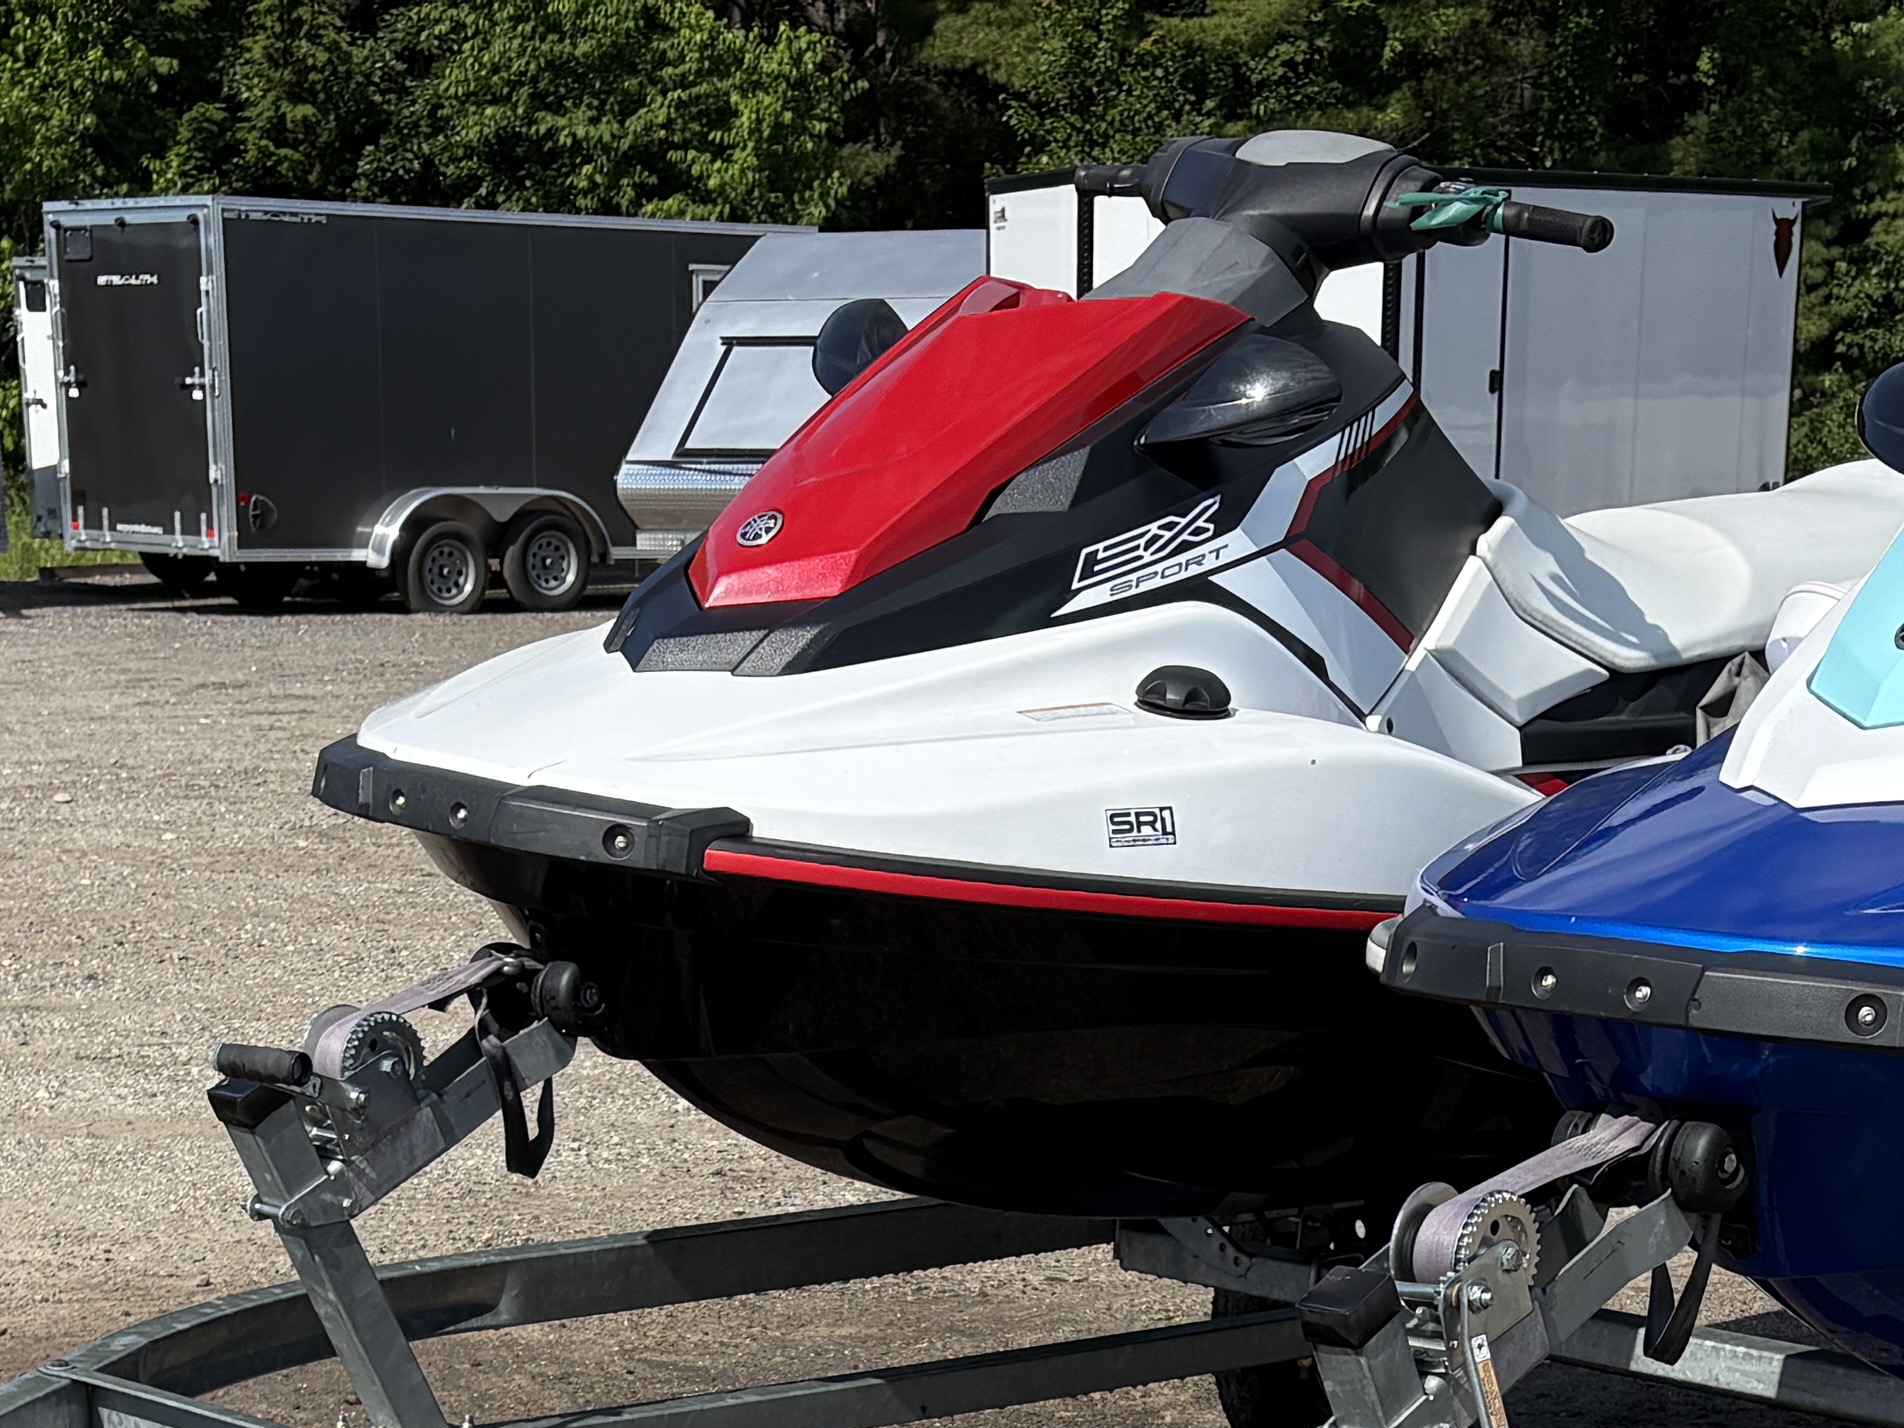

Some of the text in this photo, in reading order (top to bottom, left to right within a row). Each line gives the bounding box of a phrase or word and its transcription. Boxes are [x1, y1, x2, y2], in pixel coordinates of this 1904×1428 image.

[1071, 494, 1222, 591] EX
[1109, 543, 1229, 597] SPORT
[1109, 808, 1174, 835] SR1
